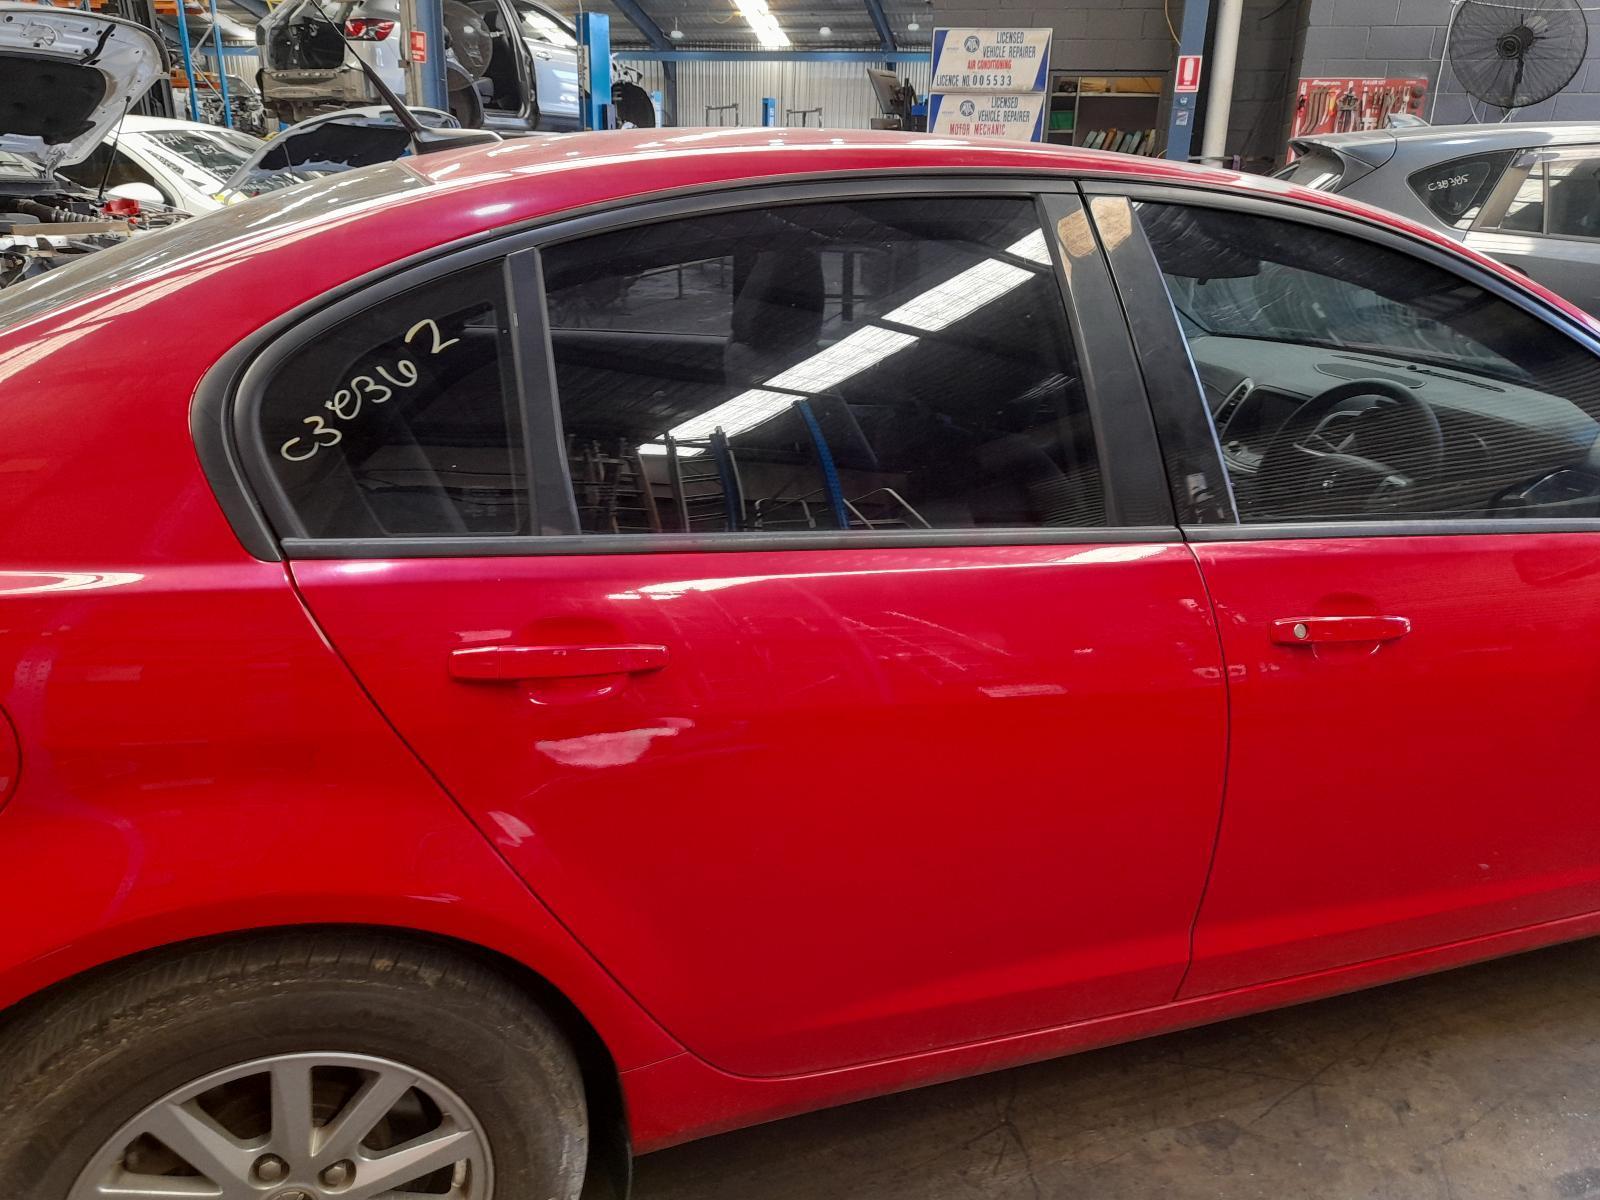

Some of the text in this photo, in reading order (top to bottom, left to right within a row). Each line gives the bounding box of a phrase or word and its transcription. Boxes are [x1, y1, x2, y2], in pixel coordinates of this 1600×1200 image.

[996, 31, 1024, 44] LICENSED
[982, 45, 1036, 58] VEHICLE REPAIRER
[967, 59, 1012, 70] AIR CONDITIONING
[936, 74, 959, 87] LICENCE
[991, 96, 1019, 109] LICENSED
[978, 110, 1031, 123] VEHICLE REPAIRER
[949, 123, 1006, 136] MOTOR MECHANIC
[280, 318, 460, 461] C38362
